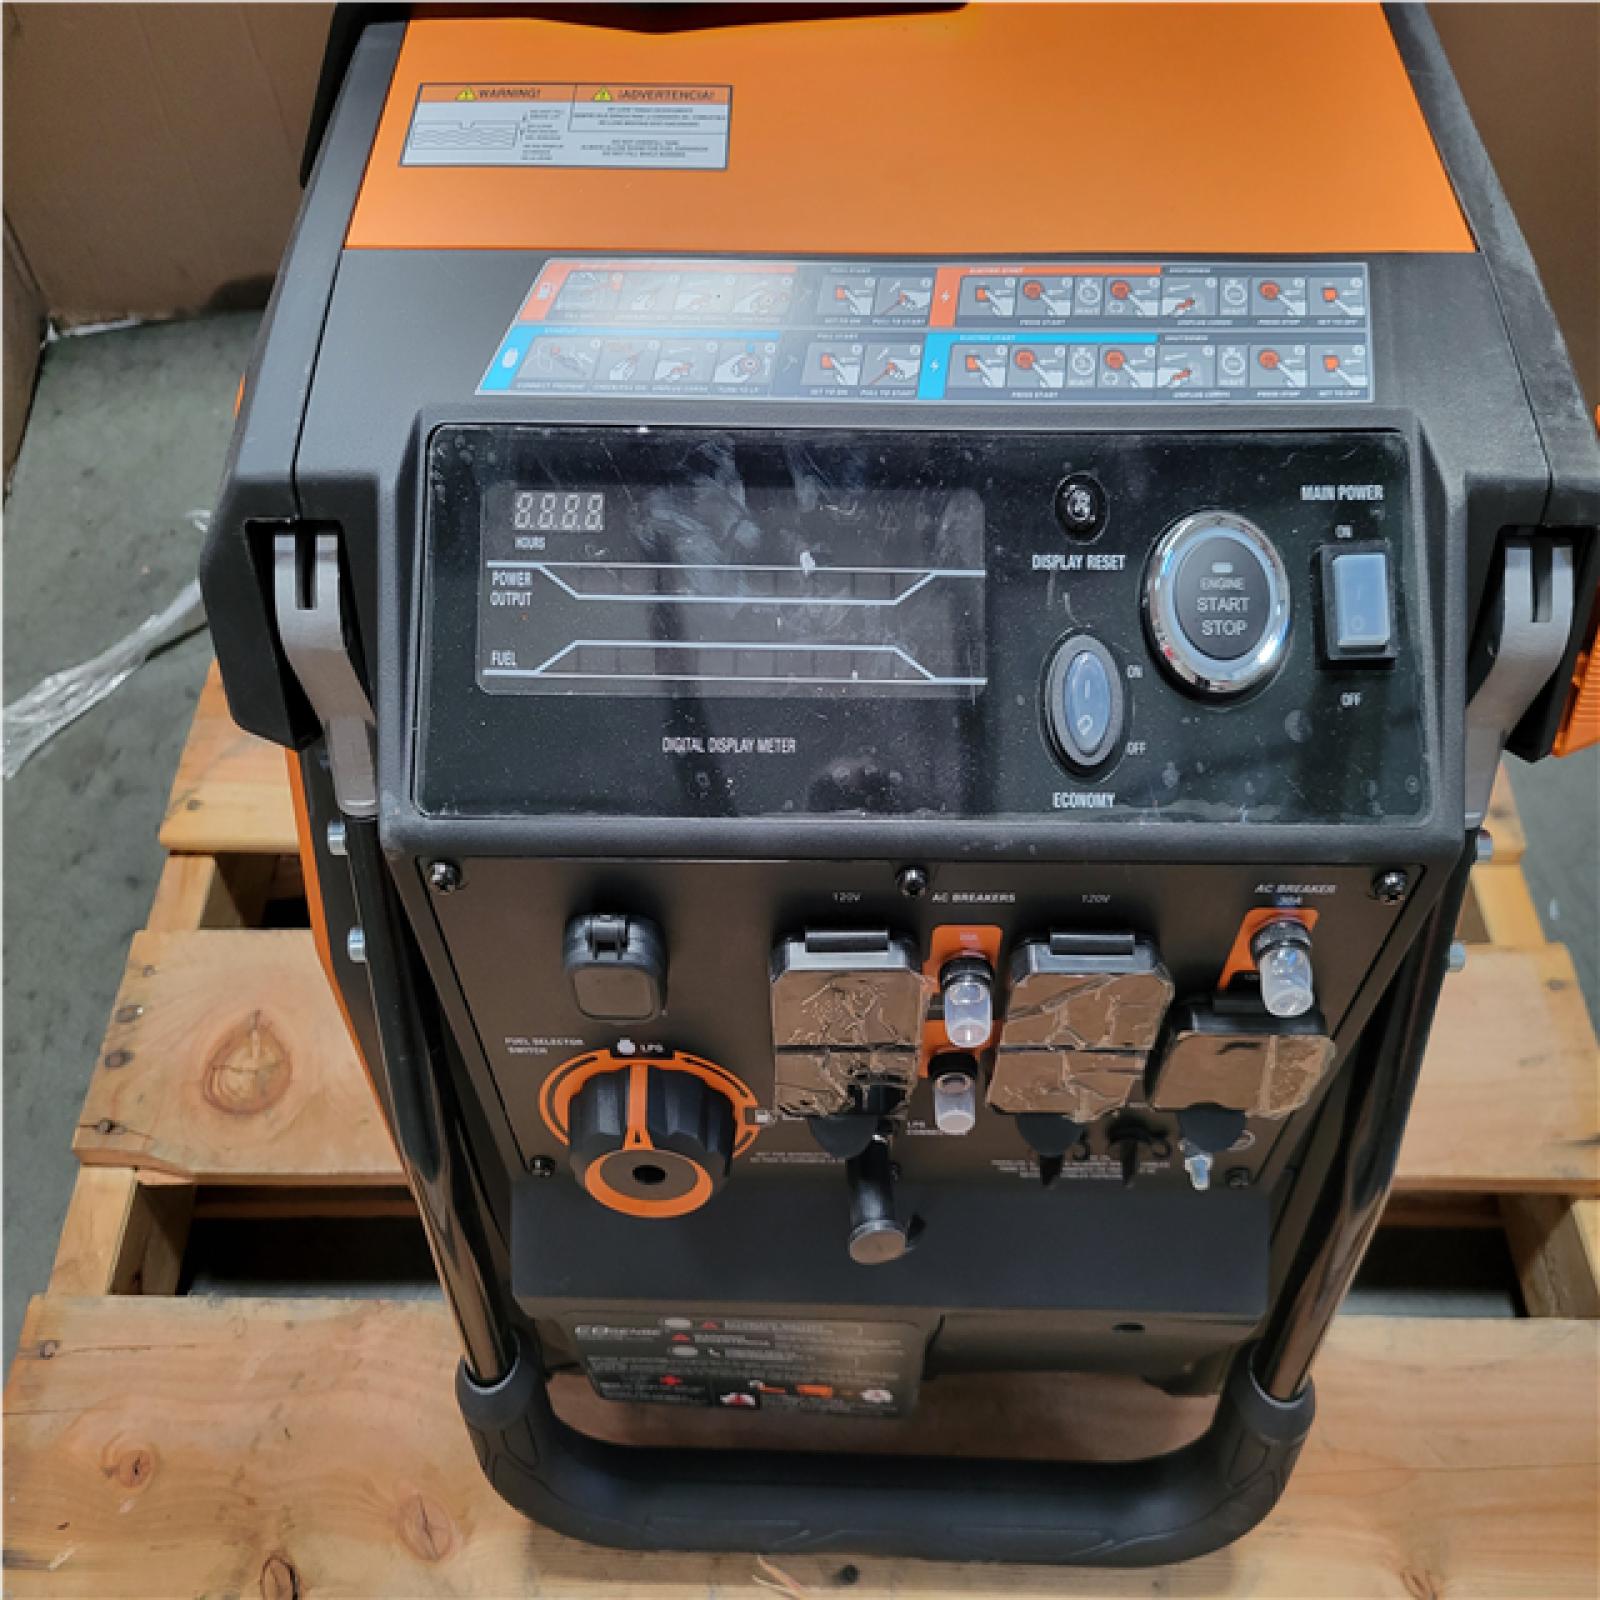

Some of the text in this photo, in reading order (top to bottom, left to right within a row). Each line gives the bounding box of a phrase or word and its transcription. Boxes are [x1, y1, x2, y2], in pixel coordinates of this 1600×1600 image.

[477, 88, 541, 99] WARNING!
[1301, 485, 1384, 500] MAIN POWER
[1335, 525, 1353, 538] ON
[514, 537, 546, 549] HOURS
[1032, 554, 1126, 571] DISPLAY RESET
[491, 571, 532, 586] POWER
[1200, 577, 1244, 591] ENGINE
[490, 592, 532, 606] OUTPUT
[1196, 597, 1249, 612] START
[1201, 620, 1248, 636] STOP
[491, 650, 517, 666] FUEL
[1127, 665, 1143, 679] ON
[1340, 693, 1362, 706] OFF
[661, 737, 796, 753] DIGITAL DISPLAY METER
[1127, 743, 1146, 755] OFF
[1053, 792, 1115, 808] ECONOMY
[1254, 884, 1336, 894] AC BREAKER
[832, 892, 861, 902] 120V
[931, 892, 1016, 904] AC BREAKERS
